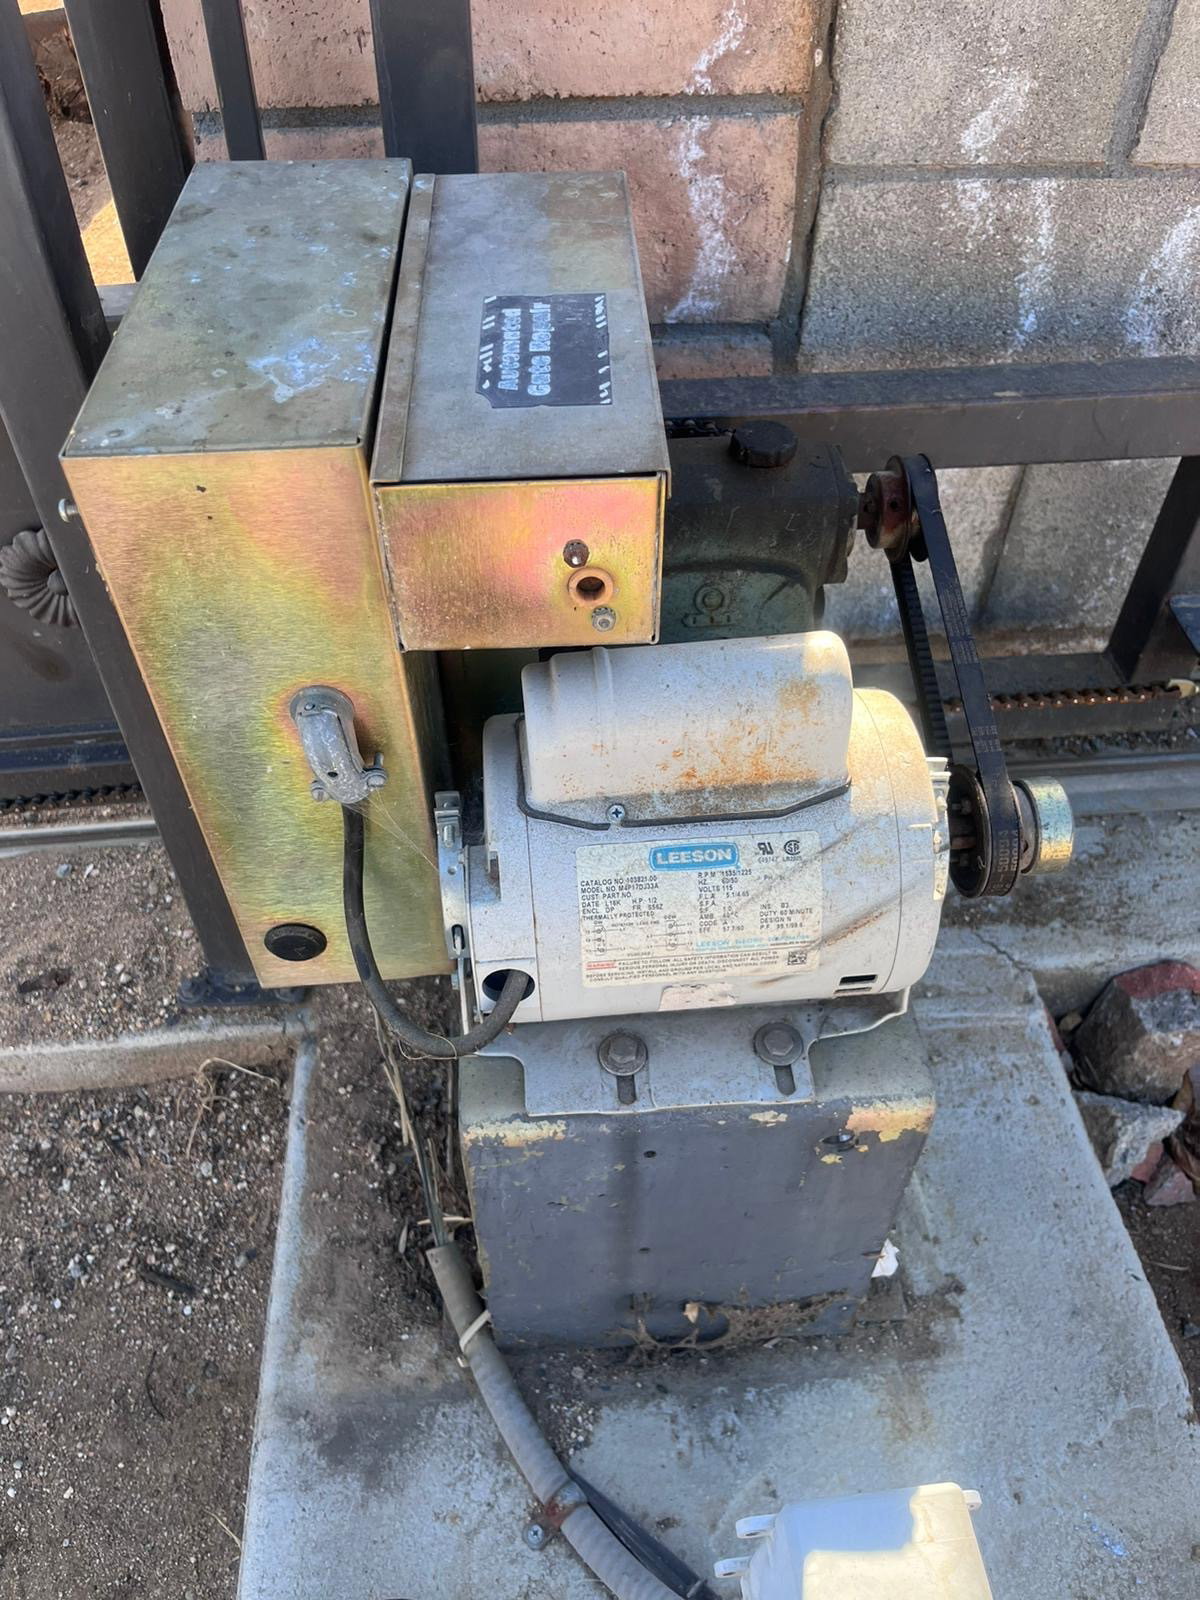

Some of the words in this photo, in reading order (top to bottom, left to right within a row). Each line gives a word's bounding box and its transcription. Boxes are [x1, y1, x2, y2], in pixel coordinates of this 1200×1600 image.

[529, 302, 555, 352] Repair
[498, 308, 521, 390] Automated
[527, 355, 551, 396] Gate
[655, 848, 732, 865] LEESON
[580, 879, 612, 887] CATALOG
[602, 892, 620, 900] PART
[789, 907, 813, 915] MINUTE
[760, 916, 785, 924] DESIGN
